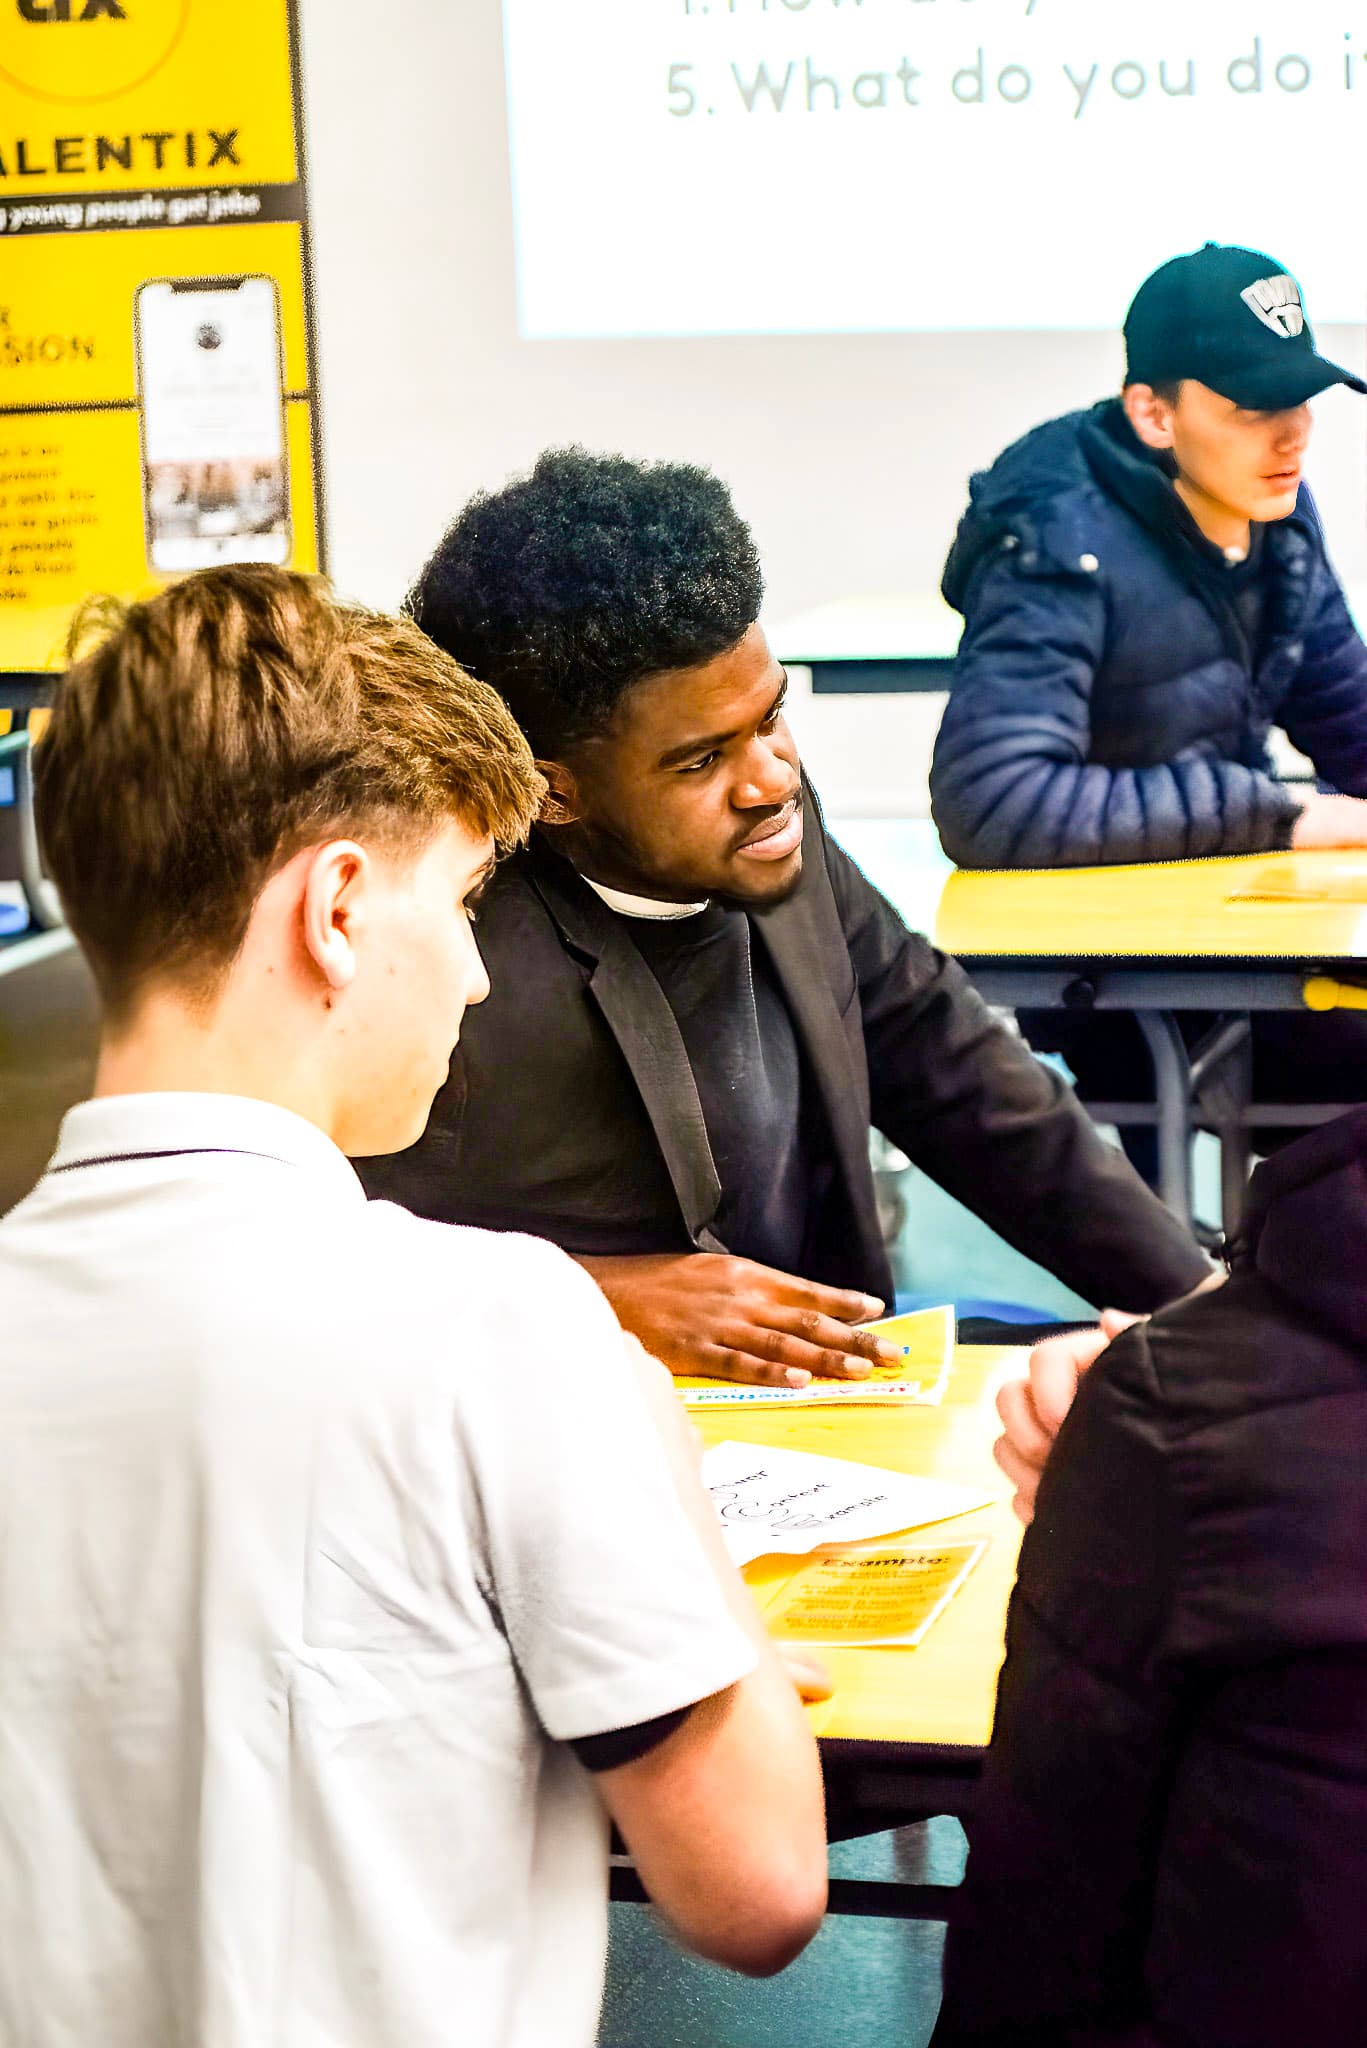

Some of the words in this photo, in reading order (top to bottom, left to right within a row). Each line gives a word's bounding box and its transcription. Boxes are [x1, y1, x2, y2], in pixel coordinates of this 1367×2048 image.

[667, 63, 714, 117] 5.
[731, 55, 921, 112] What
[951, 47, 1032, 103] do
[1062, 58, 1195, 120] you
[1227, 36, 1311, 94] do
[1344, 31, 1367, 90] i
[0, 128, 241, 177] LENTIX
